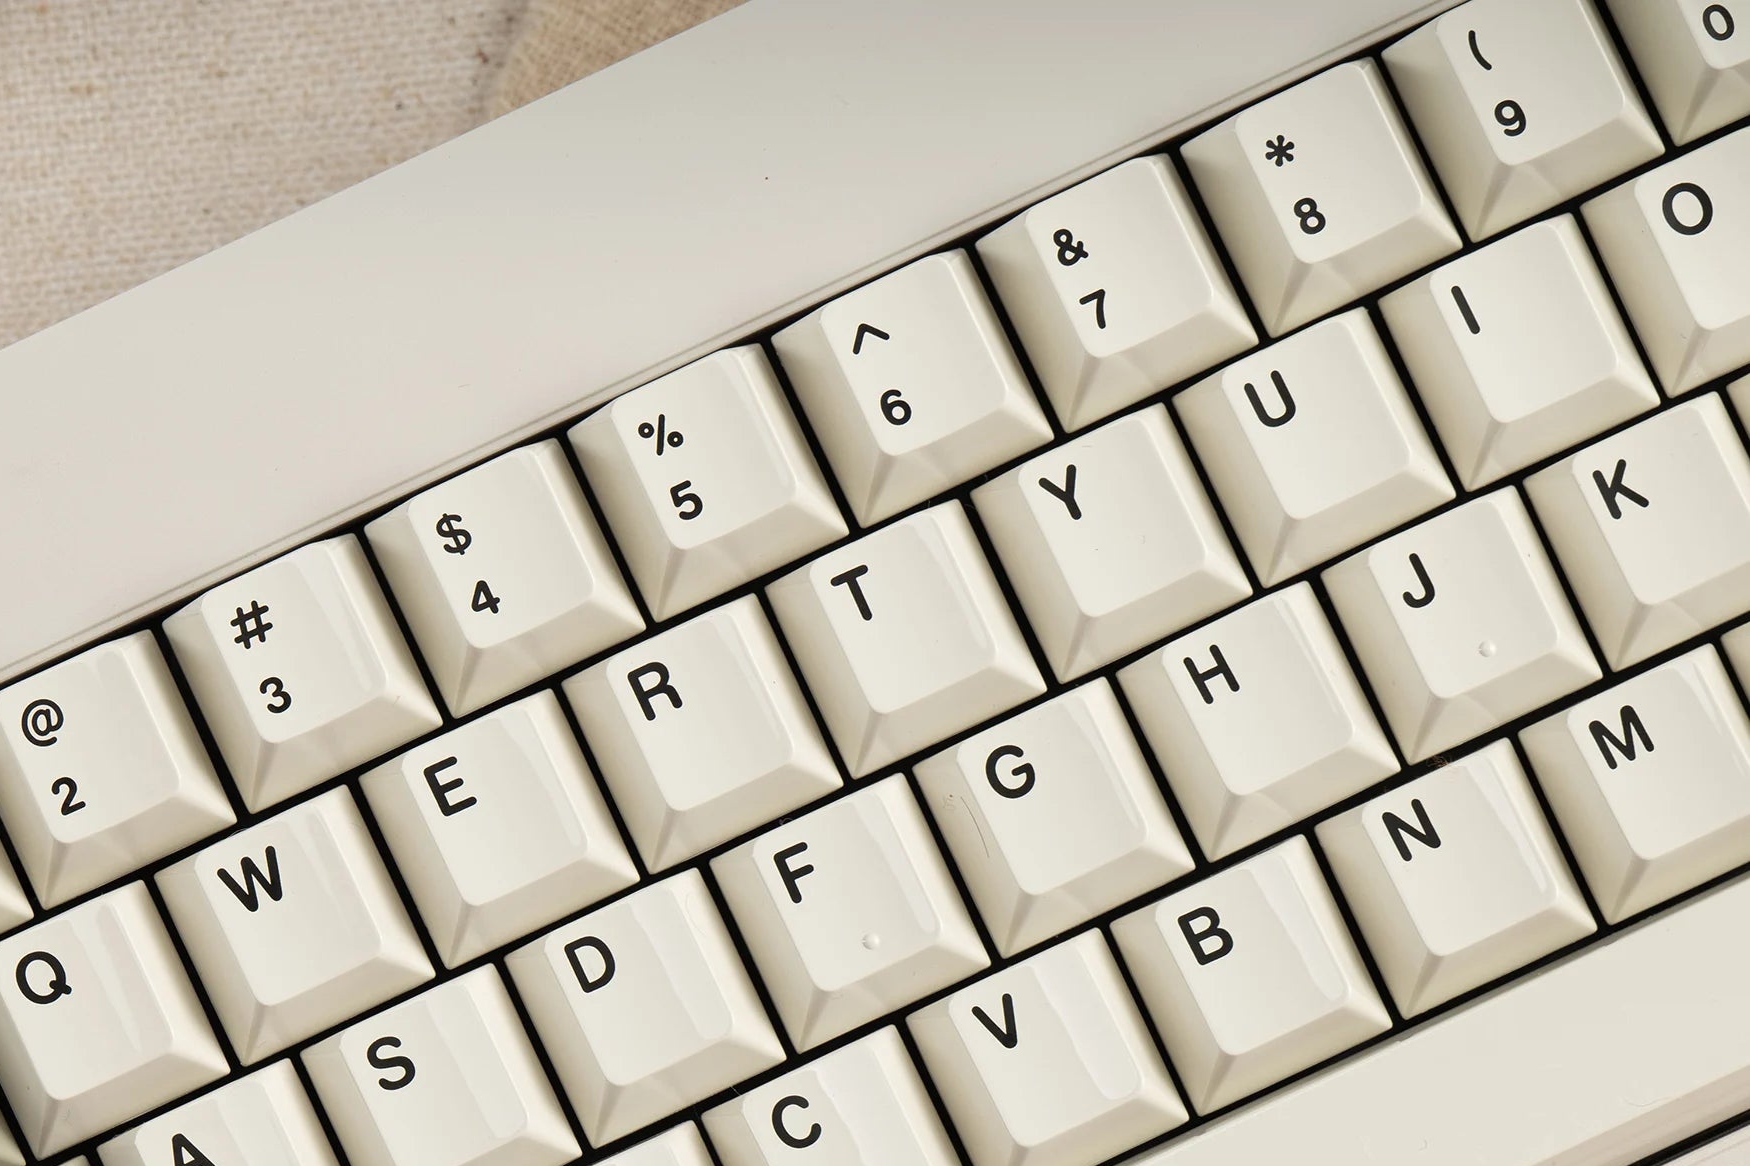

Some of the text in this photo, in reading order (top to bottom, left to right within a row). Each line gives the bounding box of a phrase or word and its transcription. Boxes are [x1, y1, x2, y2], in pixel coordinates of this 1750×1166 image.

[1468, 29, 1493, 71] (
[1702, 4, 1735, 42] 0
[1494, 99, 1527, 137] 9
[1293, 197, 1326, 235] 8
[1661, 182, 1714, 236] O
[1053, 228, 1089, 267] &
[1079, 288, 1107, 330] 7
[1450, 285, 1481, 335] I
[852, 323, 890, 355] ^
[880, 389, 912, 426] 6
[1243, 370, 1297, 428] U
[637, 413, 684, 457] %
[669, 479, 704, 521] 5
[1038, 464, 1082, 521] Y
[1592, 458, 1650, 520] K
[435, 512, 472, 556] $
[471, 580, 501, 614] 4
[830, 564, 873, 621] T
[1402, 552, 1436, 609] J
[230, 600, 274, 650] #
[259, 676, 292, 714] 3
[627, 661, 683, 722] R
[1183, 644, 1240, 705] H
[21, 698, 64, 747] @
[1588, 704, 1655, 770] M
[51, 776, 87, 816] 2
[423, 756, 478, 817] E
[985, 744, 1036, 799] G
[1381, 798, 1442, 862] N
[216, 845, 283, 913] W
[773, 841, 815, 904] F
[1177, 906, 1234, 966] B
[15, 951, 73, 1005] Q
[563, 935, 616, 994] D
[971, 993, 1018, 1049] V
[366, 1036, 416, 1091] S
[771, 1095, 822, 1149] C
